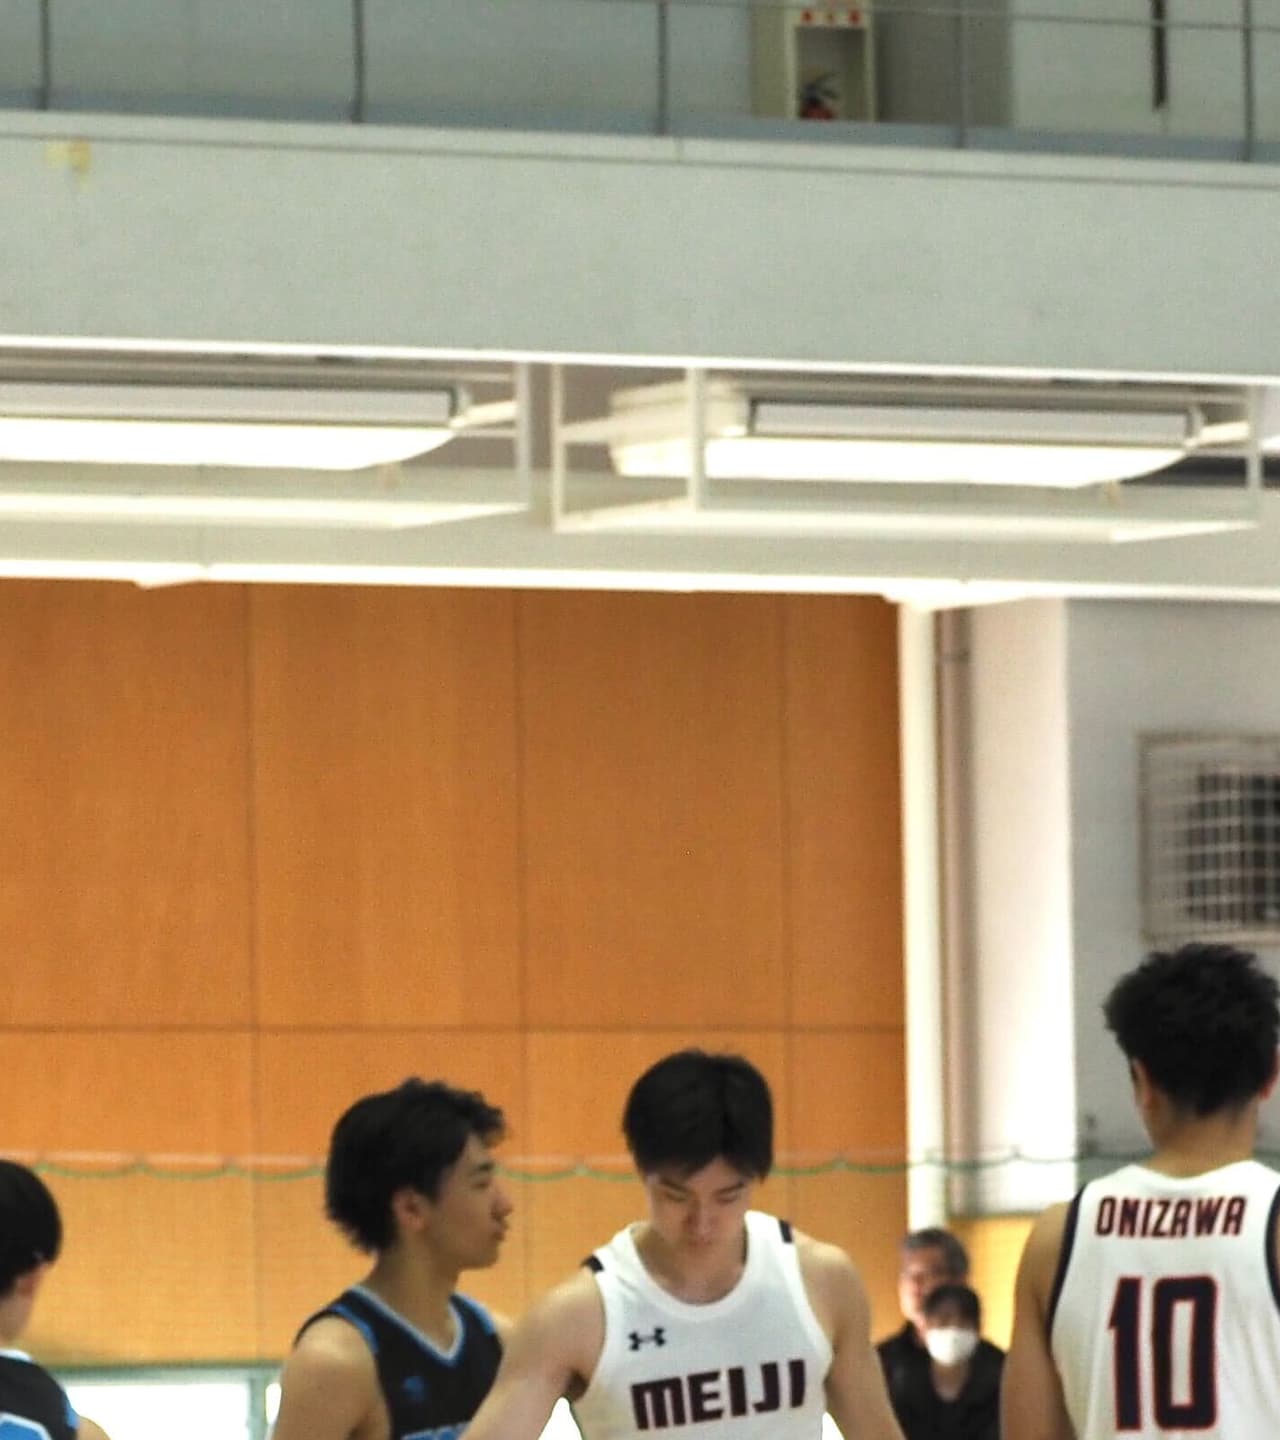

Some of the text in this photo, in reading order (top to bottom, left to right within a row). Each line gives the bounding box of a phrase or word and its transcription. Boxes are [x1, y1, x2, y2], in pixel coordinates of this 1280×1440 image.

[1095, 1196, 1247, 1238] ONIZAWA
[1108, 1275, 1218, 1431] 10
[631, 1359, 806, 1431] MEIJI
